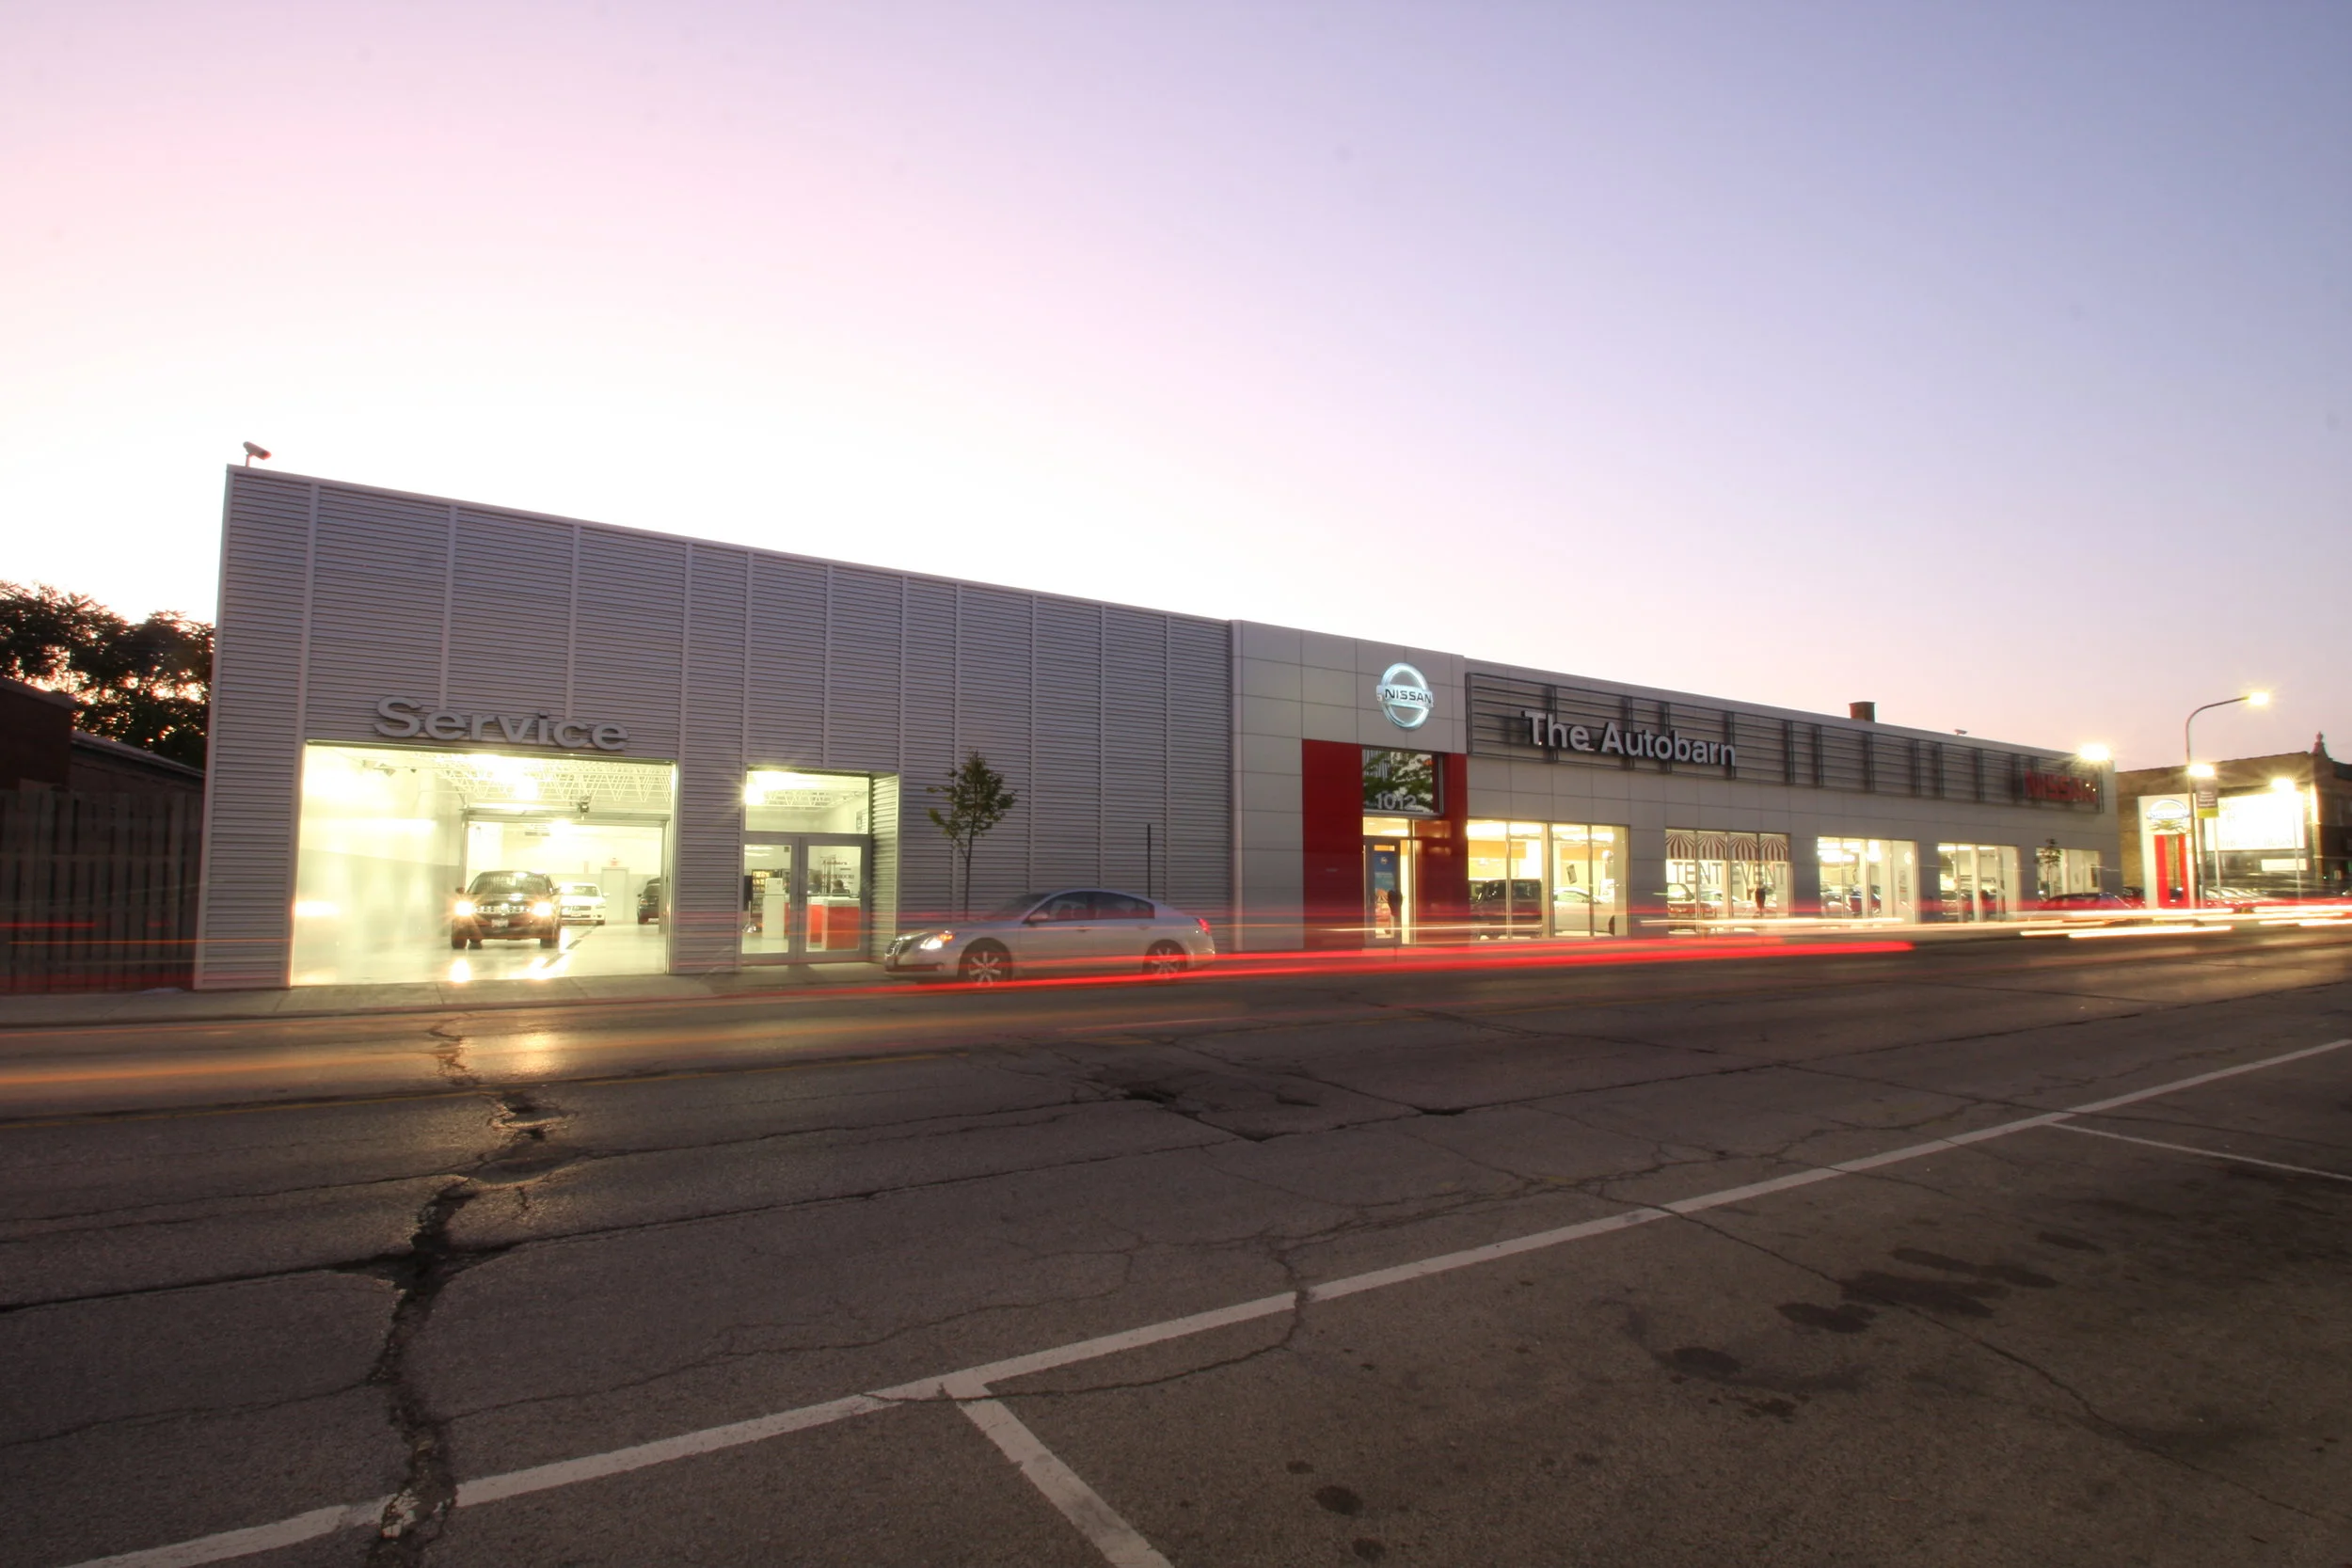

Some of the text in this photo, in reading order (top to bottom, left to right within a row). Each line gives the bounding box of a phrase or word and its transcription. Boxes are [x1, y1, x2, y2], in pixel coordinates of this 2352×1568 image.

[1384, 688, 1432, 705] NISSAN
[374, 694, 629, 752] Service
[1522, 709, 1736, 767] The Autobarn
[1375, 790, 1418, 812] 1012
[1672, 861, 1786, 885] TENT EVENT
